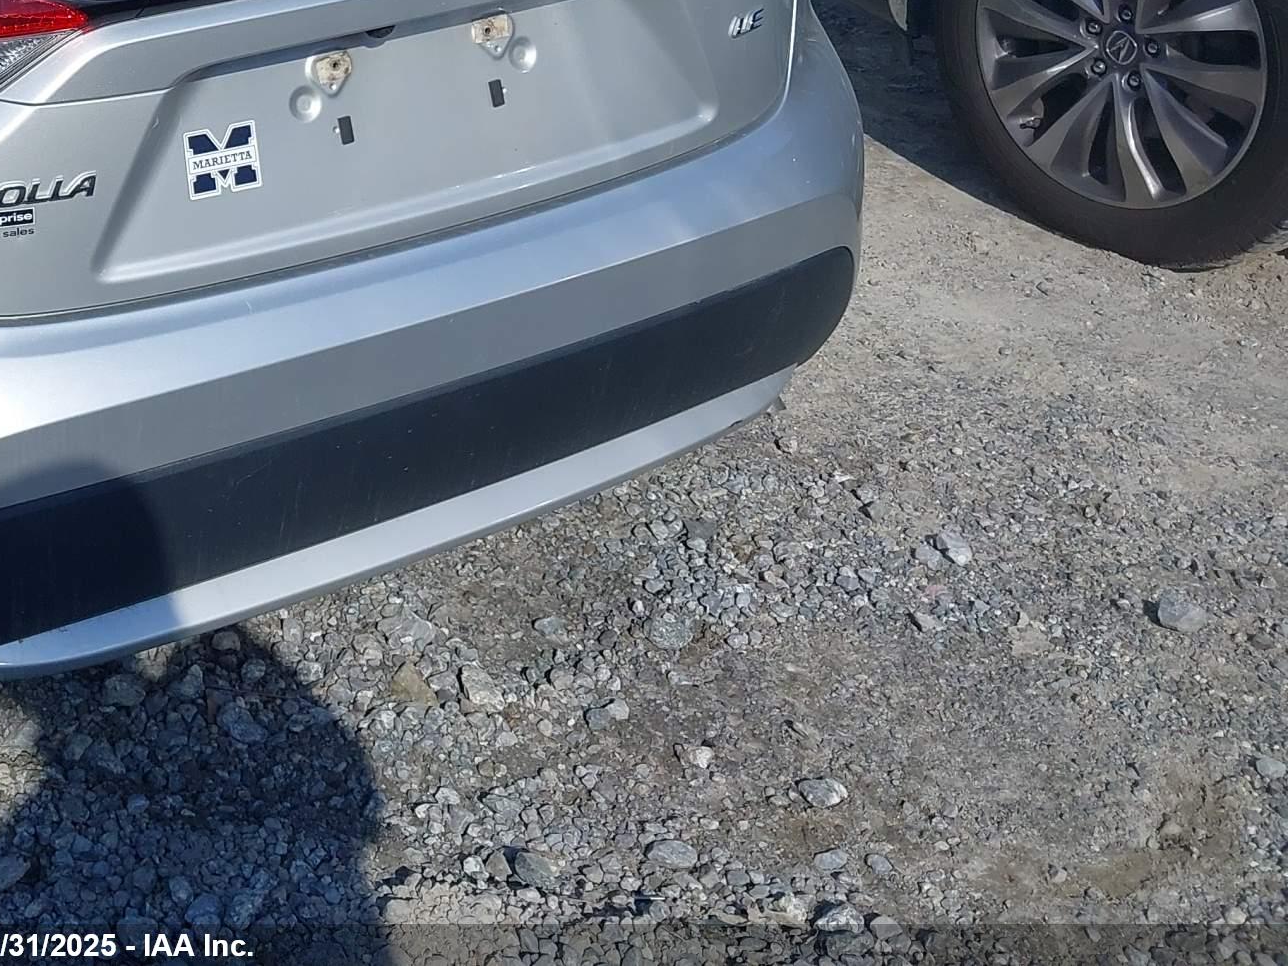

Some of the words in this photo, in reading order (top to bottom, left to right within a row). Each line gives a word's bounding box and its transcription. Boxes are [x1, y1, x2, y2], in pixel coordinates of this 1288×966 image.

[728, 8, 765, 39] LE
[192, 150, 253, 171] MARIETTA
[3, 227, 35, 238] sales
